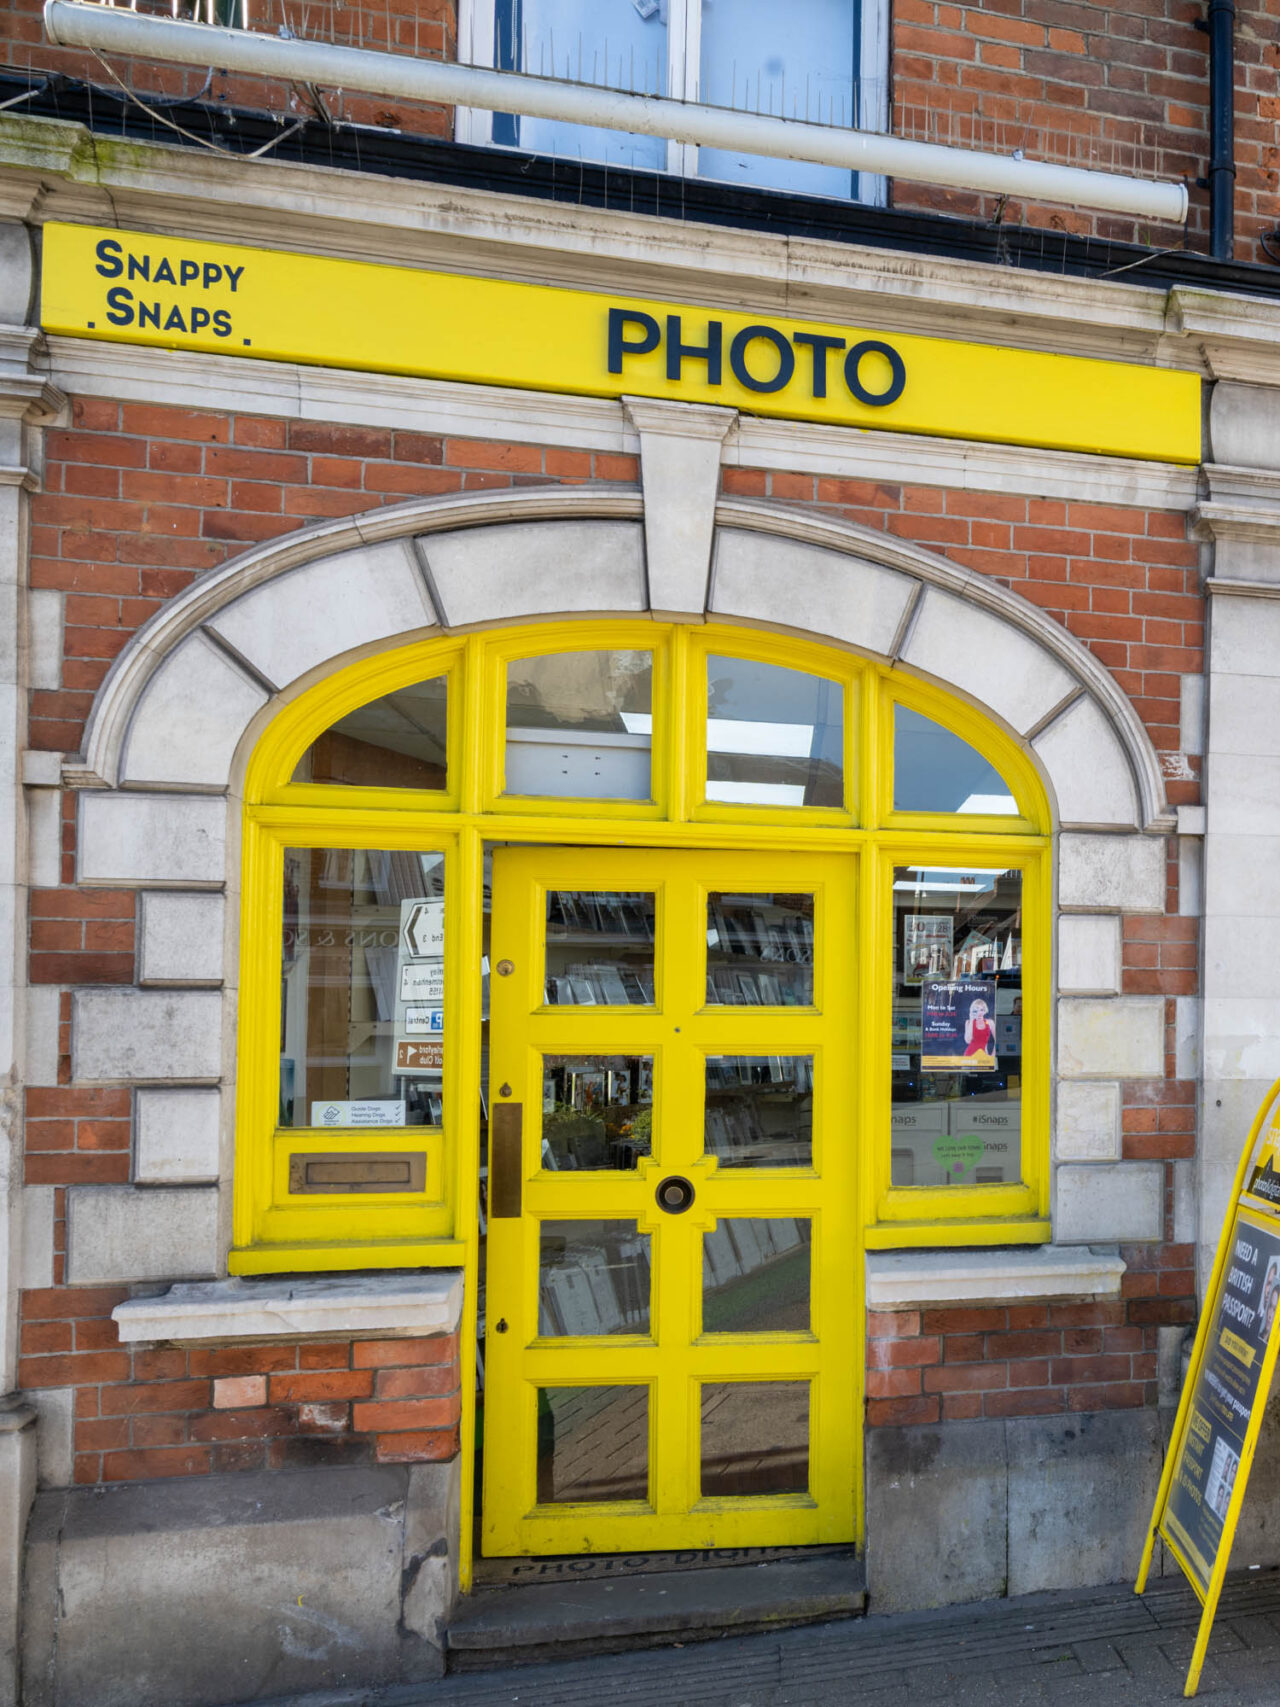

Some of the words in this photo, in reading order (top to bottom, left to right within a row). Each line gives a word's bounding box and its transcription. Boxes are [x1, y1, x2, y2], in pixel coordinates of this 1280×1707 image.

[607, 307, 906, 407] PHOTO
[931, 984, 963, 993] Opening
[972, 1114, 1009, 1125] #iSnaps
[1234, 1239, 1253, 1263] NEED
[1250, 1247, 1259, 1267] A
[1227, 1266, 1254, 1295] BRITISH
[1221, 1292, 1256, 1329] PASSPORT?
[512, 1556, 650, 1575] PHOTO
